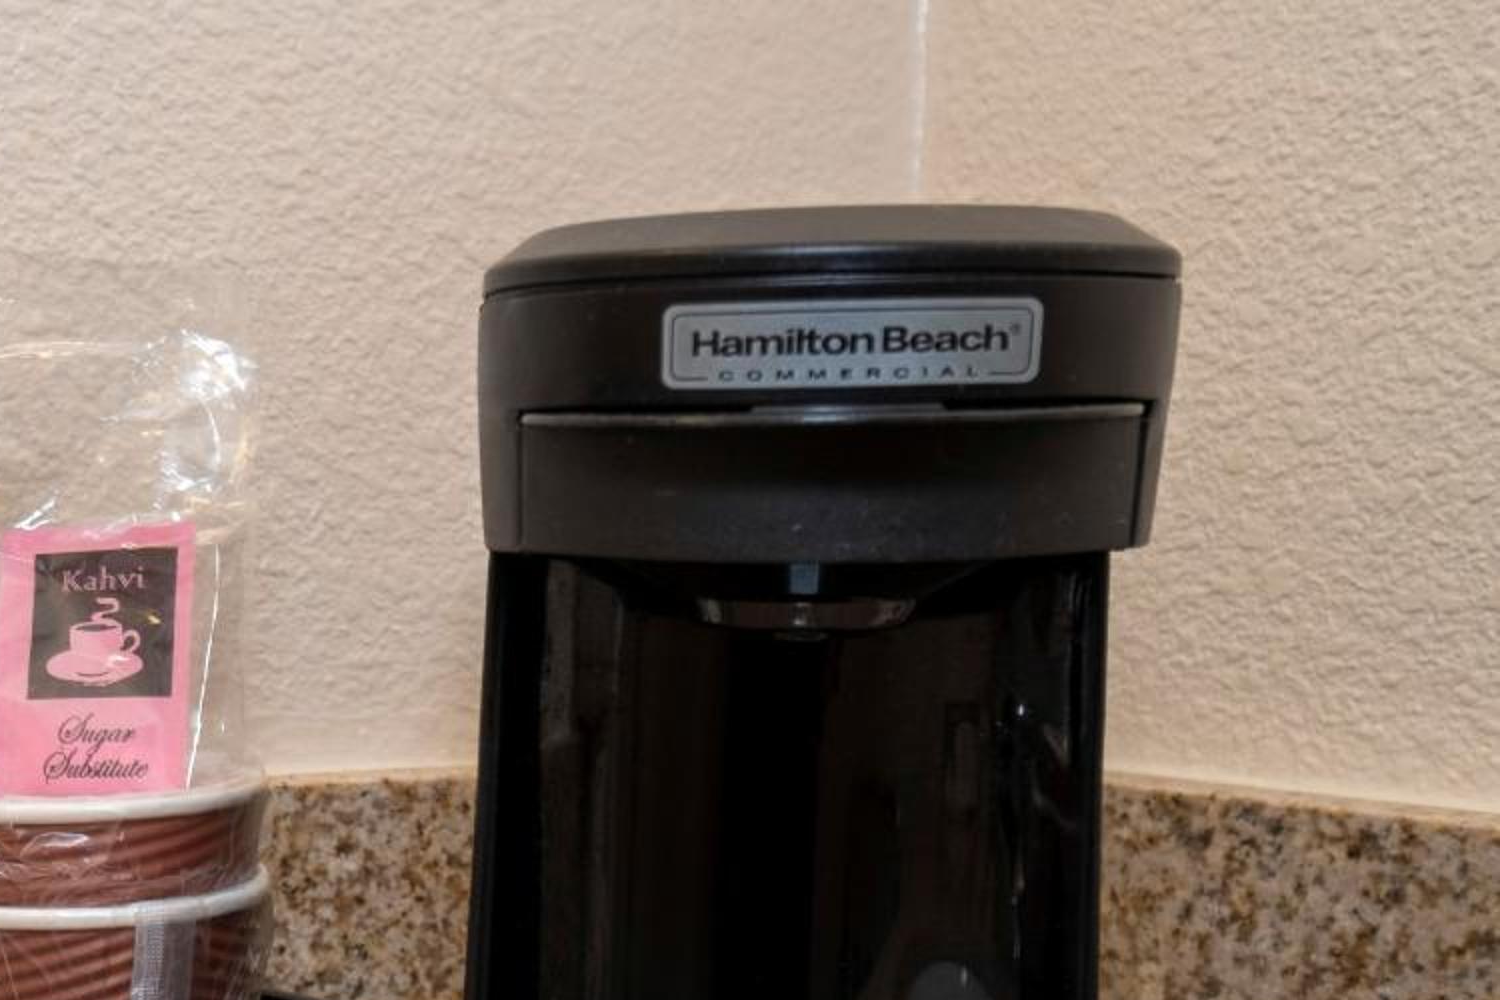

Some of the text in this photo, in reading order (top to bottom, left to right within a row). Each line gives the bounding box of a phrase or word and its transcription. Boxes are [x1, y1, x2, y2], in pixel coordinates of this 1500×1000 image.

[690, 328, 874, 358] Hamilton
[717, 366, 980, 382] COMMERCIAL
[60, 565, 147, 593] Kahvi
[56, 712, 137, 753] Sugar
[42, 748, 150, 784] Substitute
